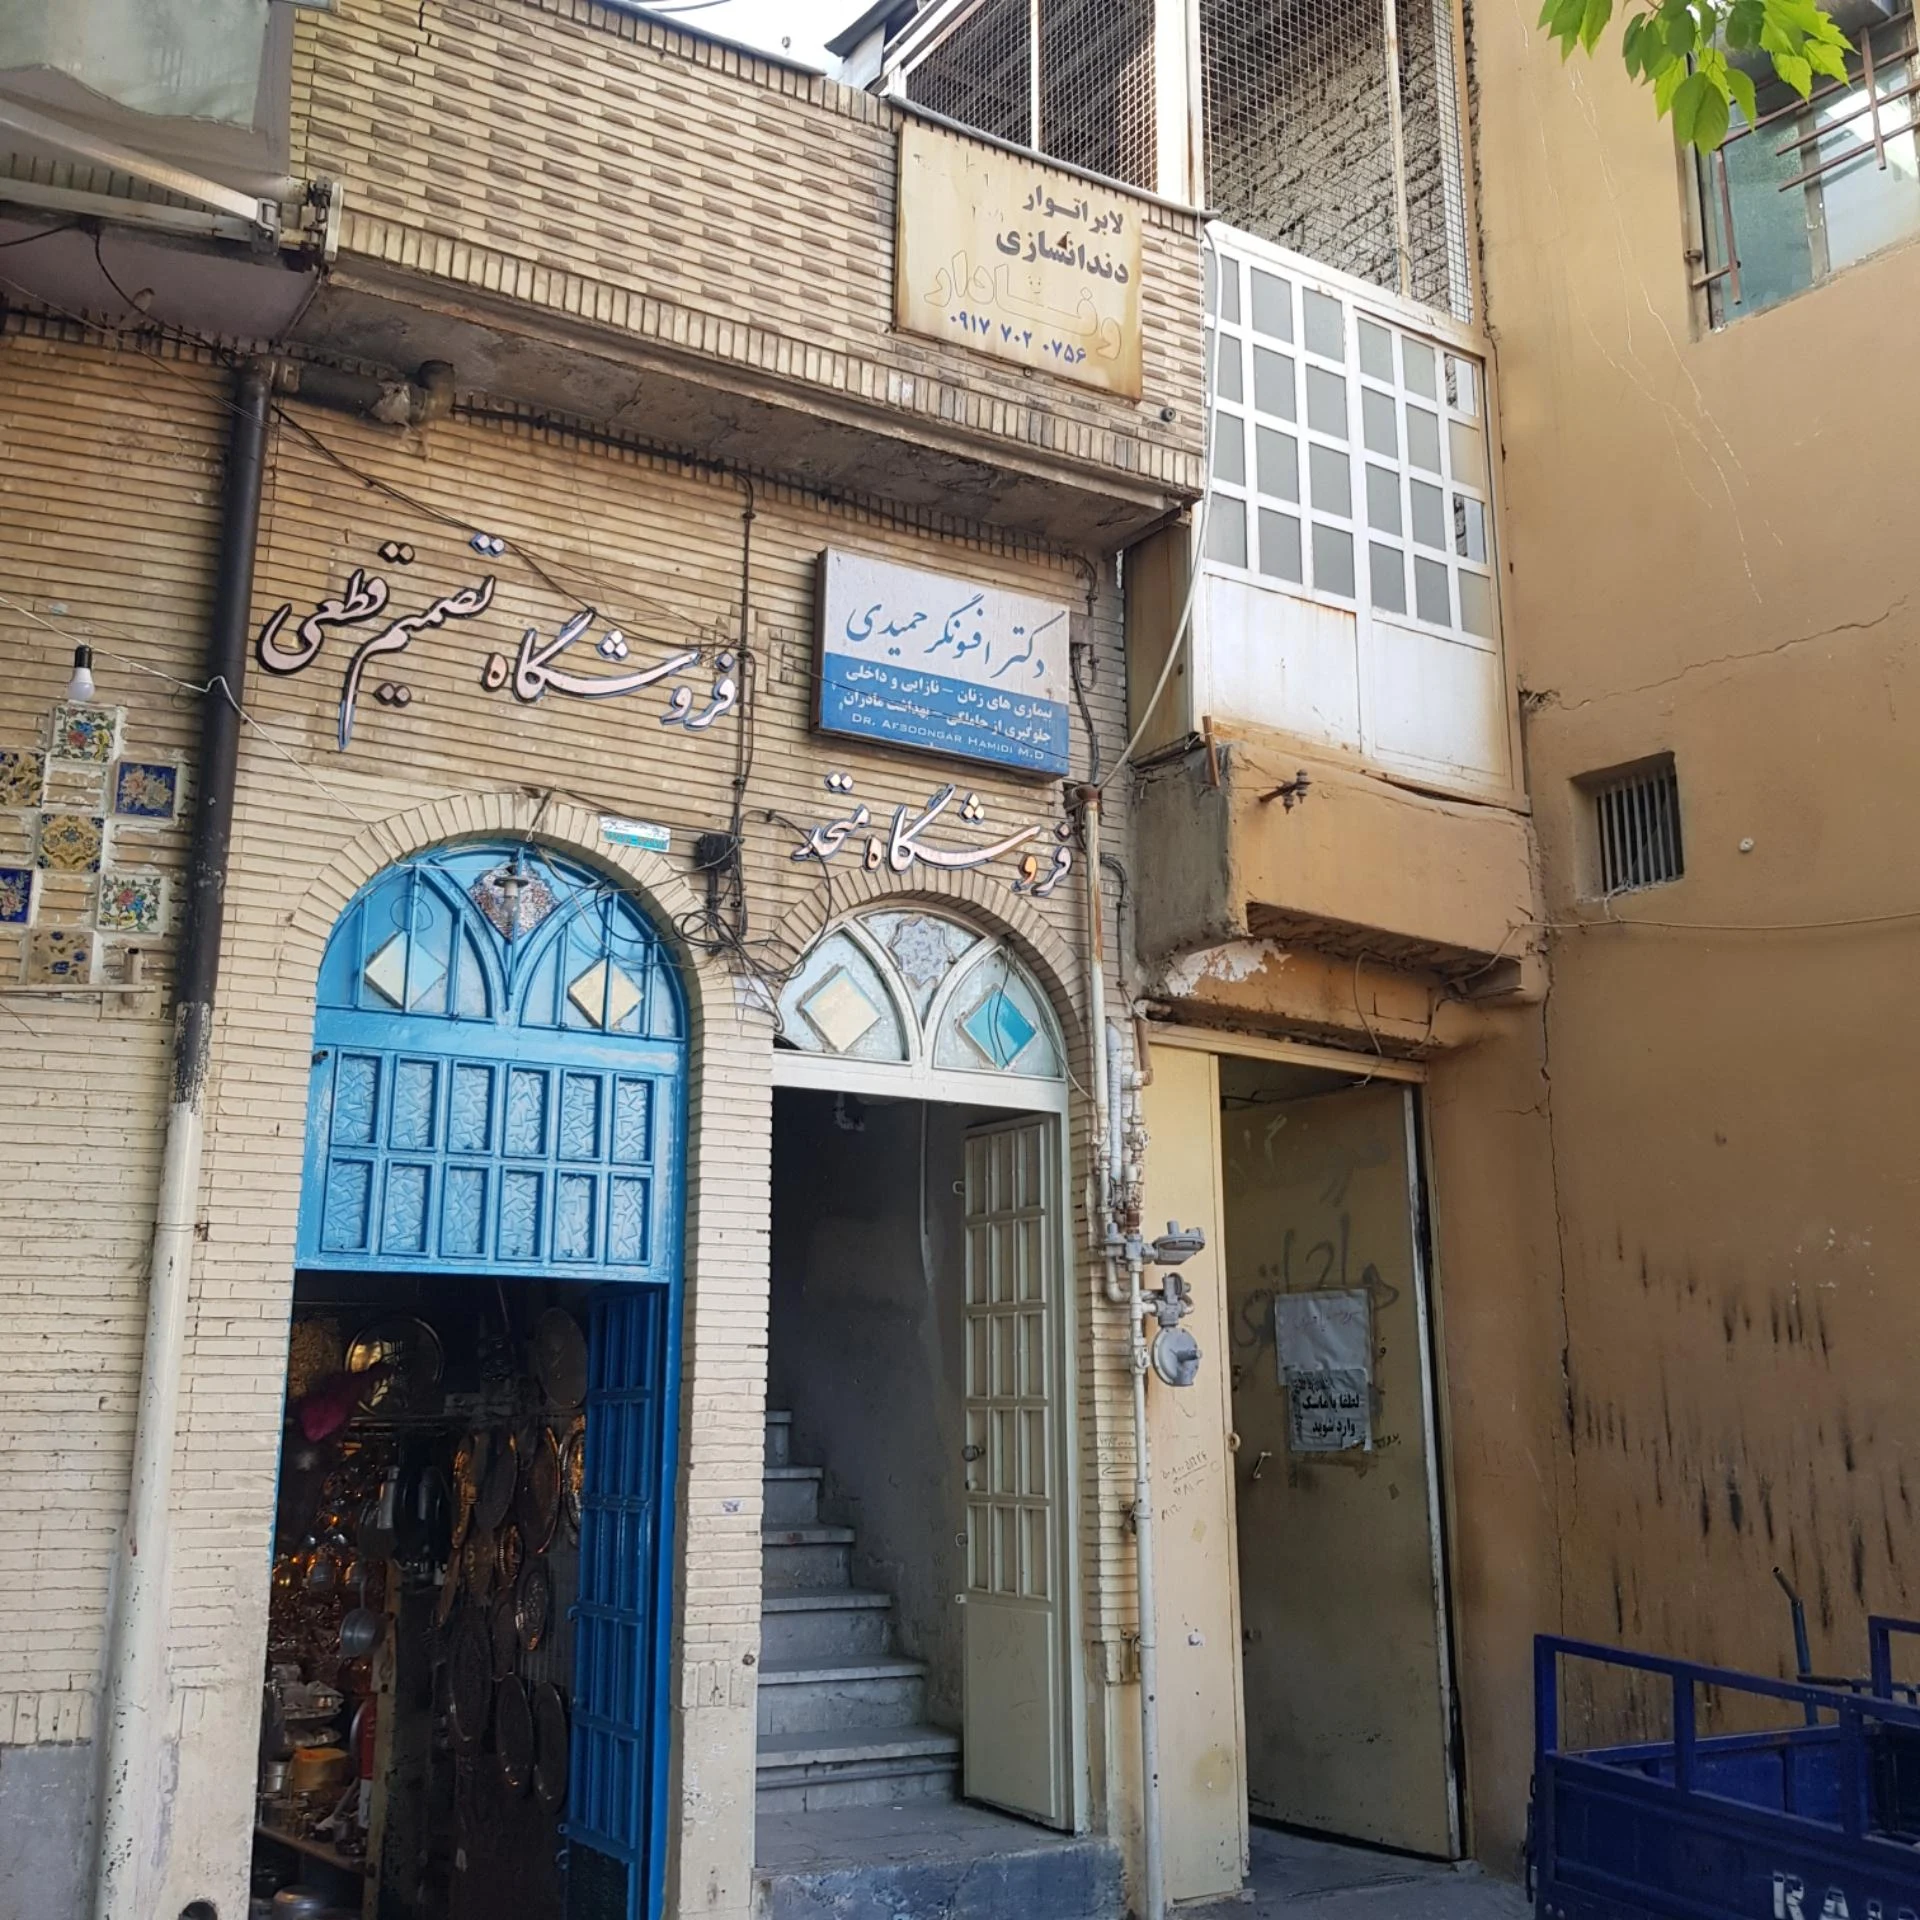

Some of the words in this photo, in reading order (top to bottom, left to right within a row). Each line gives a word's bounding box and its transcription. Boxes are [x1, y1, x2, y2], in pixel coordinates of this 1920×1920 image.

[1022, 184, 1124, 235] لابراتوار
[996, 230, 1129, 284] دندانسازی
[950, 311, 990, 336] ۰۹۱۷
[1000, 323, 1032, 349] ۷۰۲
[1043, 339, 1086, 364] ۰۷۵۶
[256, 540, 416, 676] قطعی
[845, 603, 928, 656] حمیدی
[338, 532, 506, 752] تصمیم
[989, 609, 1066, 679] دکتر
[481, 606, 736, 731] فروشگاه
[846, 664, 888, 682] داخلی
[890, 677, 898, 690] و
[901, 676, 940, 697] نازایی
[843, 690, 884, 709] مادران
[957, 687, 984, 708] زنان
[986, 695, 1011, 711] های
[1013, 702, 1053, 721] بیماری
[851, 712, 876, 727] DR.
[881, 719, 963, 744] AFSOONGAR
[968, 735, 1014, 754] HAMIDI
[991, 719, 1003, 736] از
[863, 783, 1074, 897] فروشگاه
[1302, 1394, 1329, 1410] ماسک
[1339, 1393, 1360, 1409] لطفا
[1312, 1418, 1335, 1438] شوید
[1336, 1417, 1356, 1437] وارد
